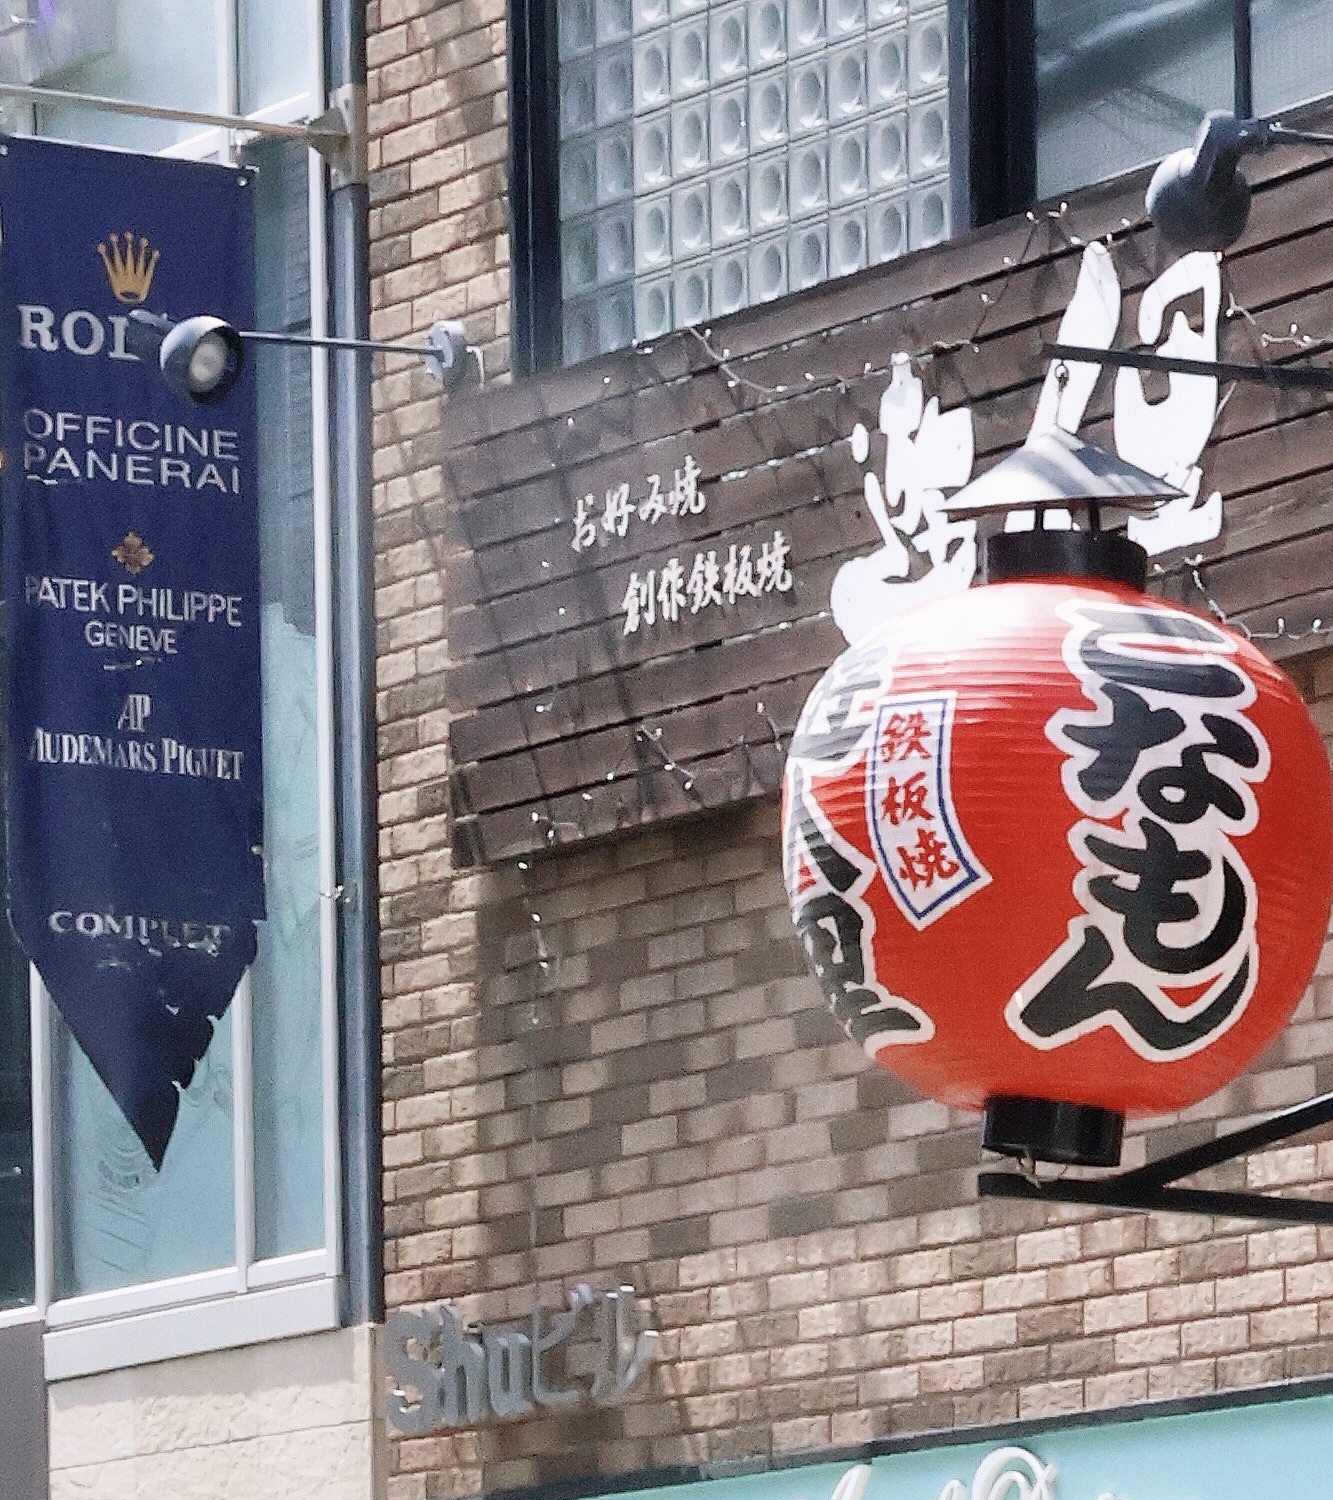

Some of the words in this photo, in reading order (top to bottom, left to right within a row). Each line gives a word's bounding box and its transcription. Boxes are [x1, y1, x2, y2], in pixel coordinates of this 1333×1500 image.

[24, 409, 239, 461] OFFICINE
[24, 443, 240, 494] PANERAI
[571, 454, 706, 552] お好み焼
[25, 575, 109, 614] PATEK
[118, 583, 243, 627] PHILIPPE
[622, 530, 793, 635] 創作鉄板焼
[31, 727, 158, 773] AUDEMARS
[161, 737, 244, 781] PIGUET
[879, 710, 960, 889] 鉄板焼
[1012, 604, 1268, 1057] こなもん
